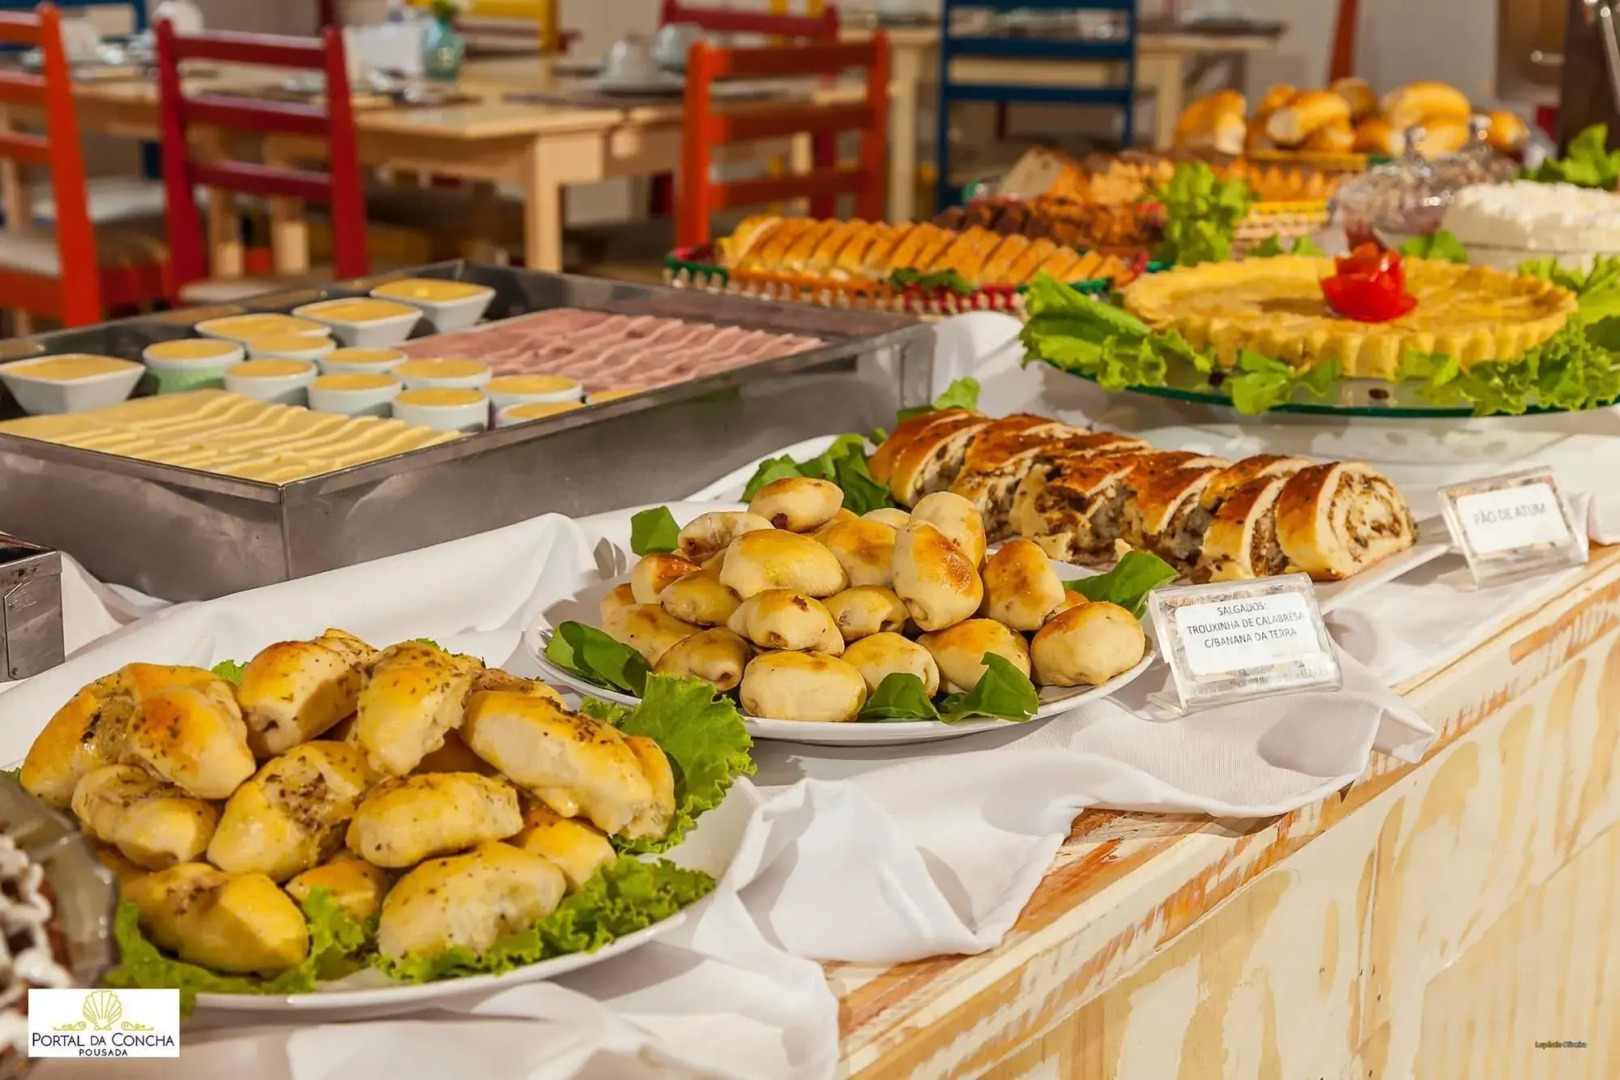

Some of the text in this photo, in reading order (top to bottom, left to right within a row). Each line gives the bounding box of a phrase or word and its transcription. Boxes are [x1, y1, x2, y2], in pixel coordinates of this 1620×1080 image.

[1473, 503, 1547, 525] PÃO DE ATUM
[1187, 611, 1305, 635] TROUXINHA DE CALABRESA
[1204, 627, 1298, 649] C/BANANA DA TERRA
